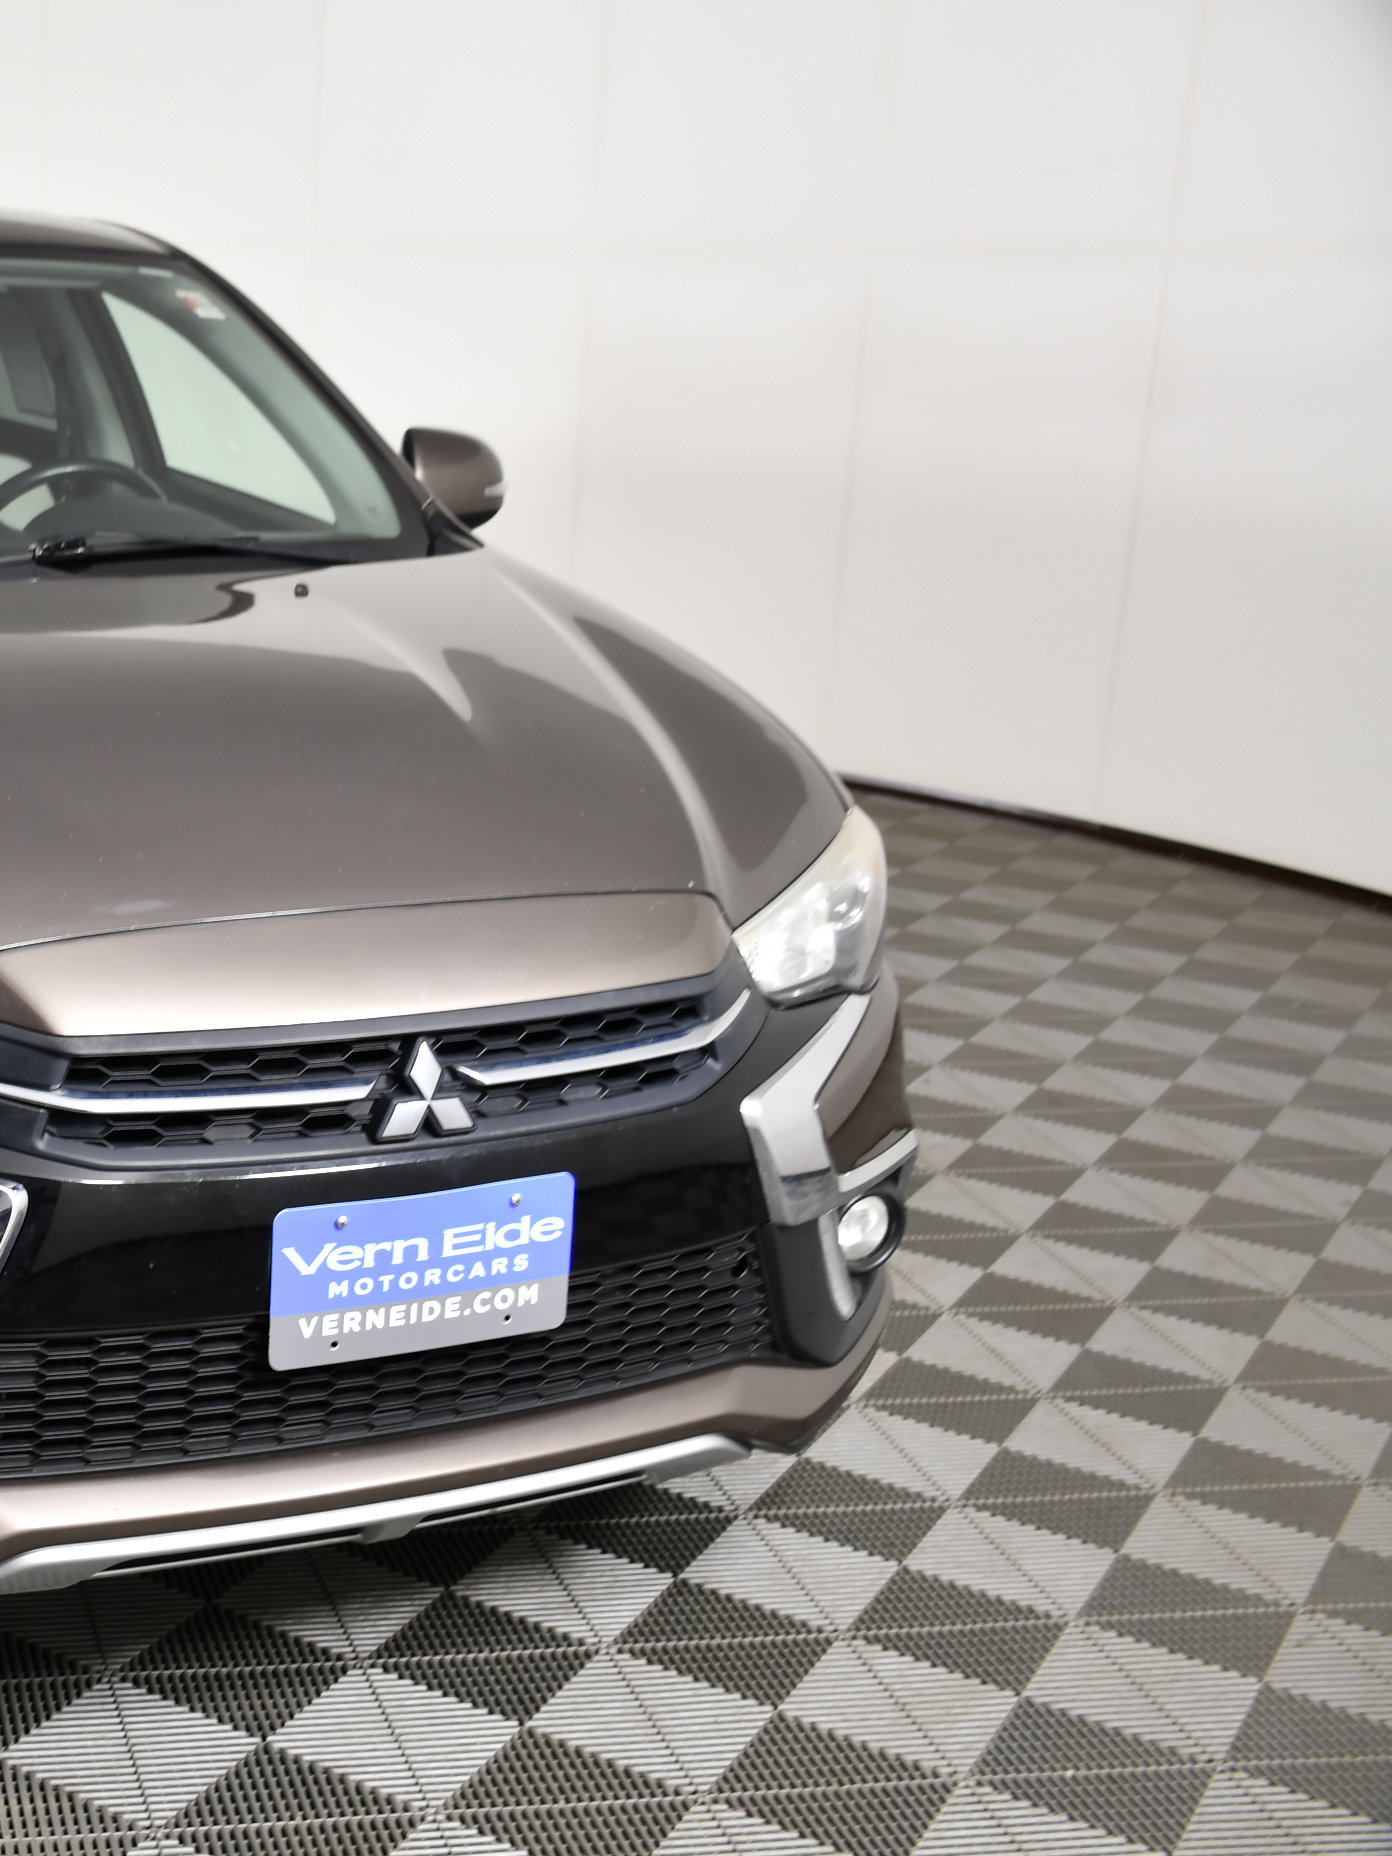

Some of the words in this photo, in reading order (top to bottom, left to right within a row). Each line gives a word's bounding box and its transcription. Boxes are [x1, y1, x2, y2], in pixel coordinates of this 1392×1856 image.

[281, 1236, 430, 1276] Vern
[441, 1214, 565, 1258] Eide
[328, 1253, 530, 1299] MOTORCARS
[298, 1283, 539, 1339] VERNEIDE.COM
